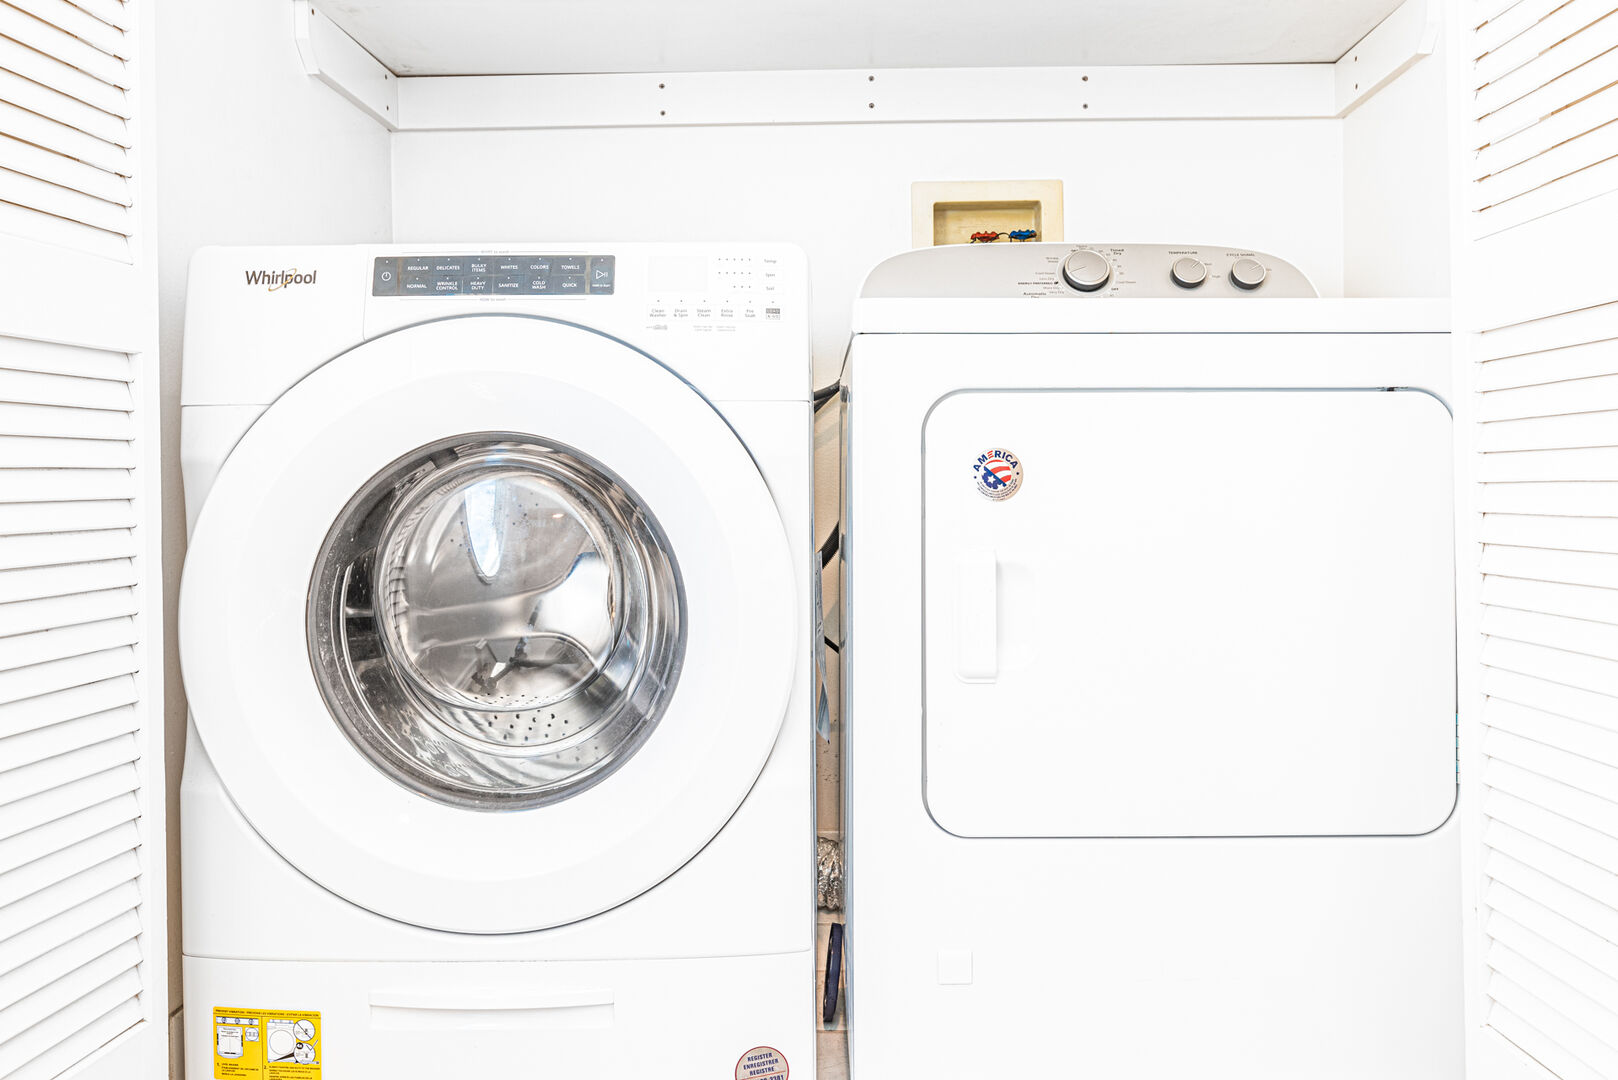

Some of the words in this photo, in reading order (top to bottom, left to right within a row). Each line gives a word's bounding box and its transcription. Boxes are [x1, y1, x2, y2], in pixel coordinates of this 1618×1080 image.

[245, 270, 317, 288] Whirlpool
[973, 450, 1018, 472] AMERICA
[748, 1052, 772, 1062] REGISTER
[743, 1058, 779, 1070] ENREGISTRER
[750, 1066, 774, 1076] REGISTRE
